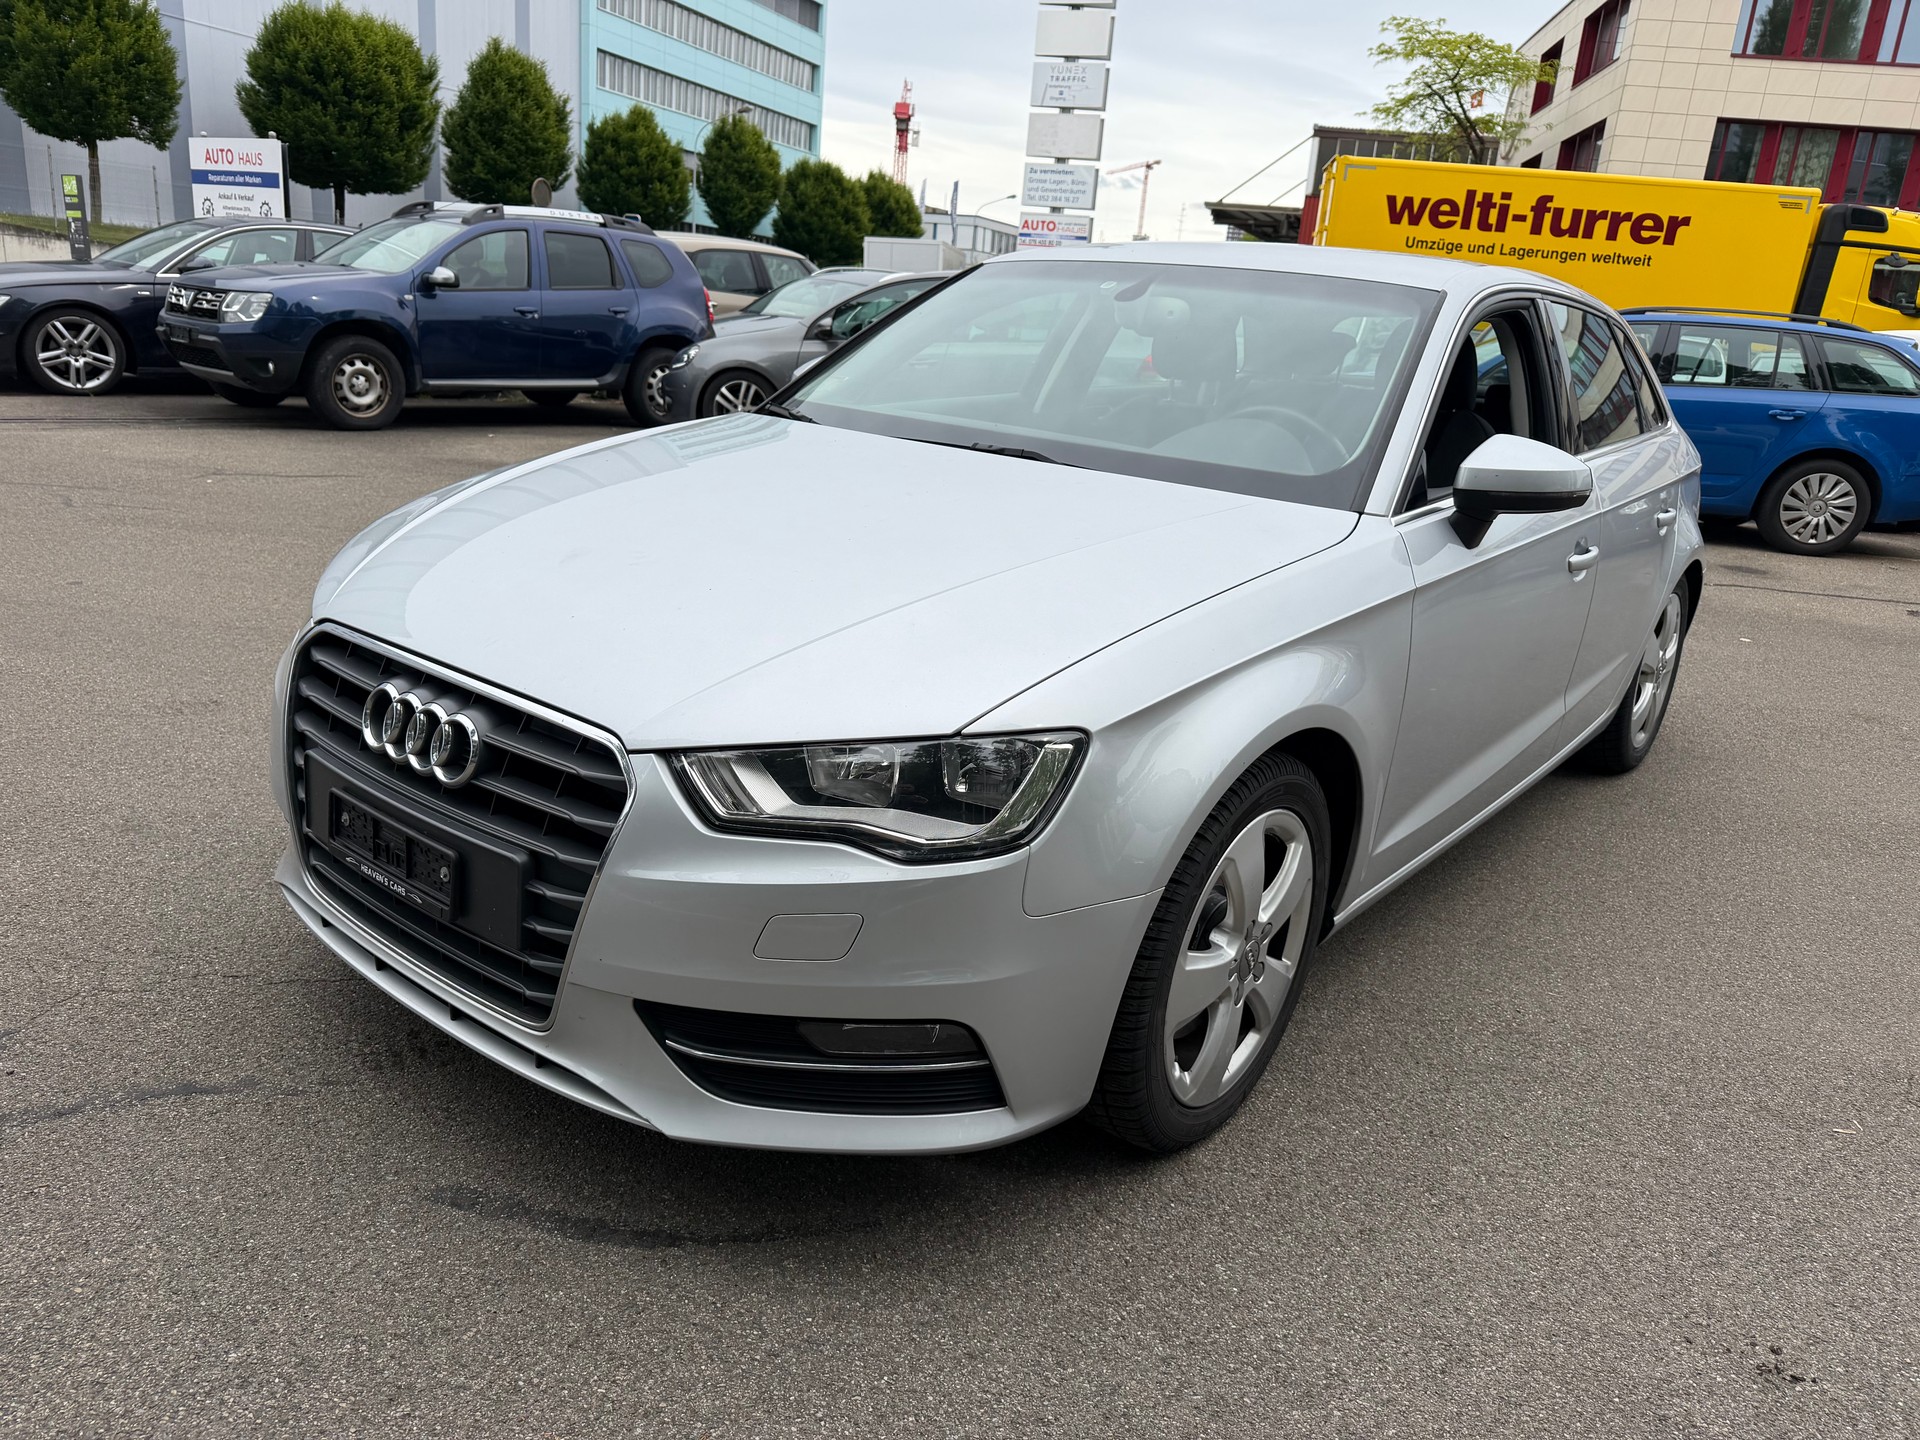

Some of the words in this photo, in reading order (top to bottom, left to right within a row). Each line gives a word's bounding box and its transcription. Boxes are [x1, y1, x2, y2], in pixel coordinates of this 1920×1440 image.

[1050, 66, 1087, 74] YUNEX
[205, 148, 233, 164] AUTO
[238, 152, 263, 166] HAUS
[208, 174, 234, 182] Reparaturen
[550, 210, 600, 220] DUSTER
[1386, 189, 1692, 246] welti-furrer
[1022, 220, 1056, 232] AUTO
[1405, 236, 1462, 255] Umzüge
[1467, 242, 1494, 255] und
[1500, 244, 1586, 263] Lagerungen
[1592, 253, 1652, 267] weltweit
[361, 864, 388, 886] HEAVEN'S
[390, 881, 405, 896] CARS
